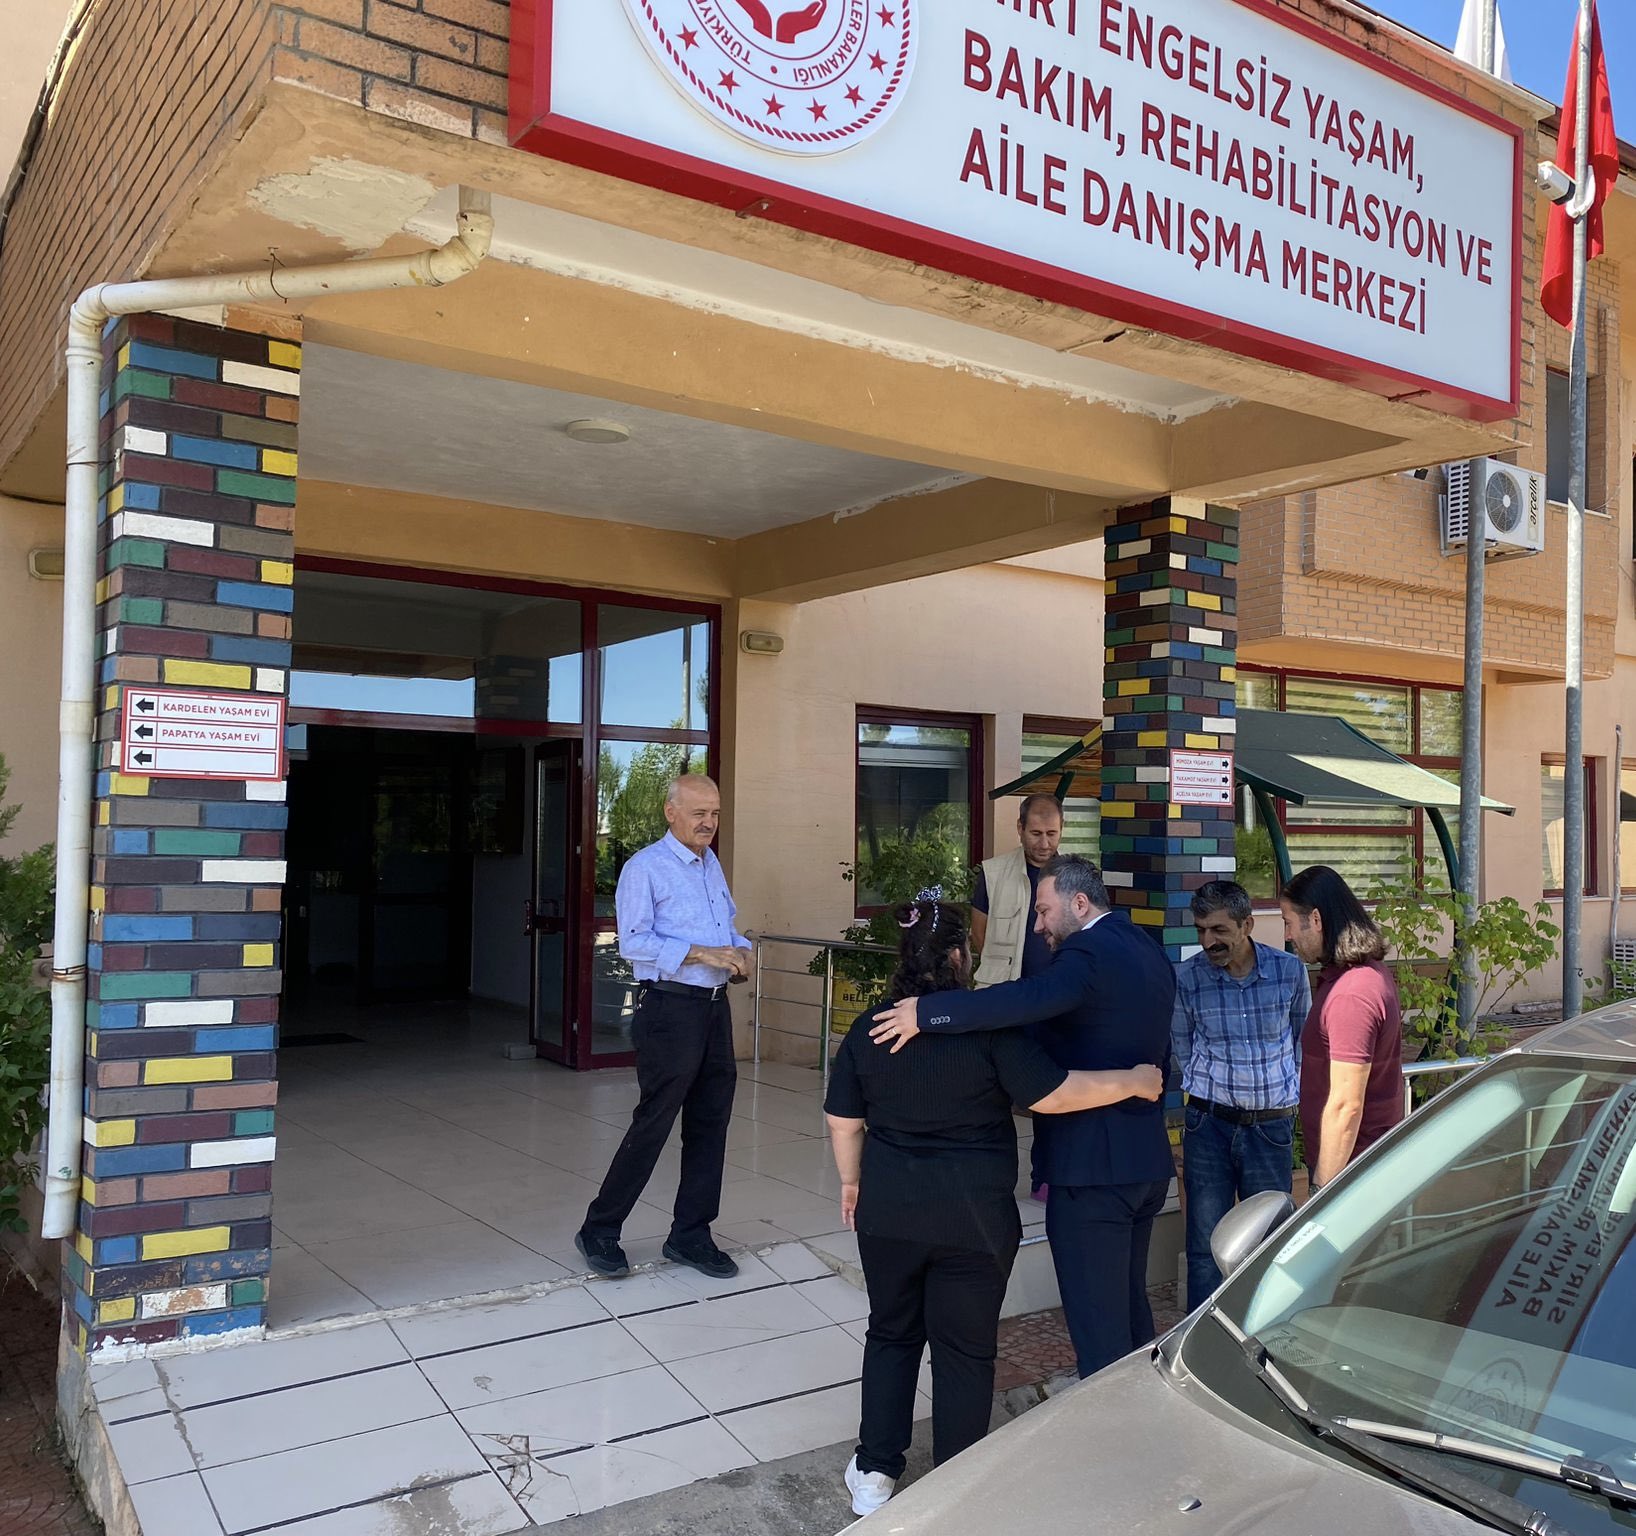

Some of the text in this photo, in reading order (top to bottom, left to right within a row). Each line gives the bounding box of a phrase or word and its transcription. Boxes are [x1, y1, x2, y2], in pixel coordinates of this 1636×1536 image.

[793, 31, 857, 85] BAKANLIĞI
[1099, 0, 1423, 194] ENGELSİZ YAŞAM,
[964, 28, 1492, 285] BAKIM, REHABİLİTASYON VE
[959, 123, 1426, 335] AİLE DANIŞMA MERKEZİ
[162, 729, 260, 742] PAPATYA YAŞAM EVİ
[163, 703, 270, 718] KARDELEN YAŞAM EVİ
